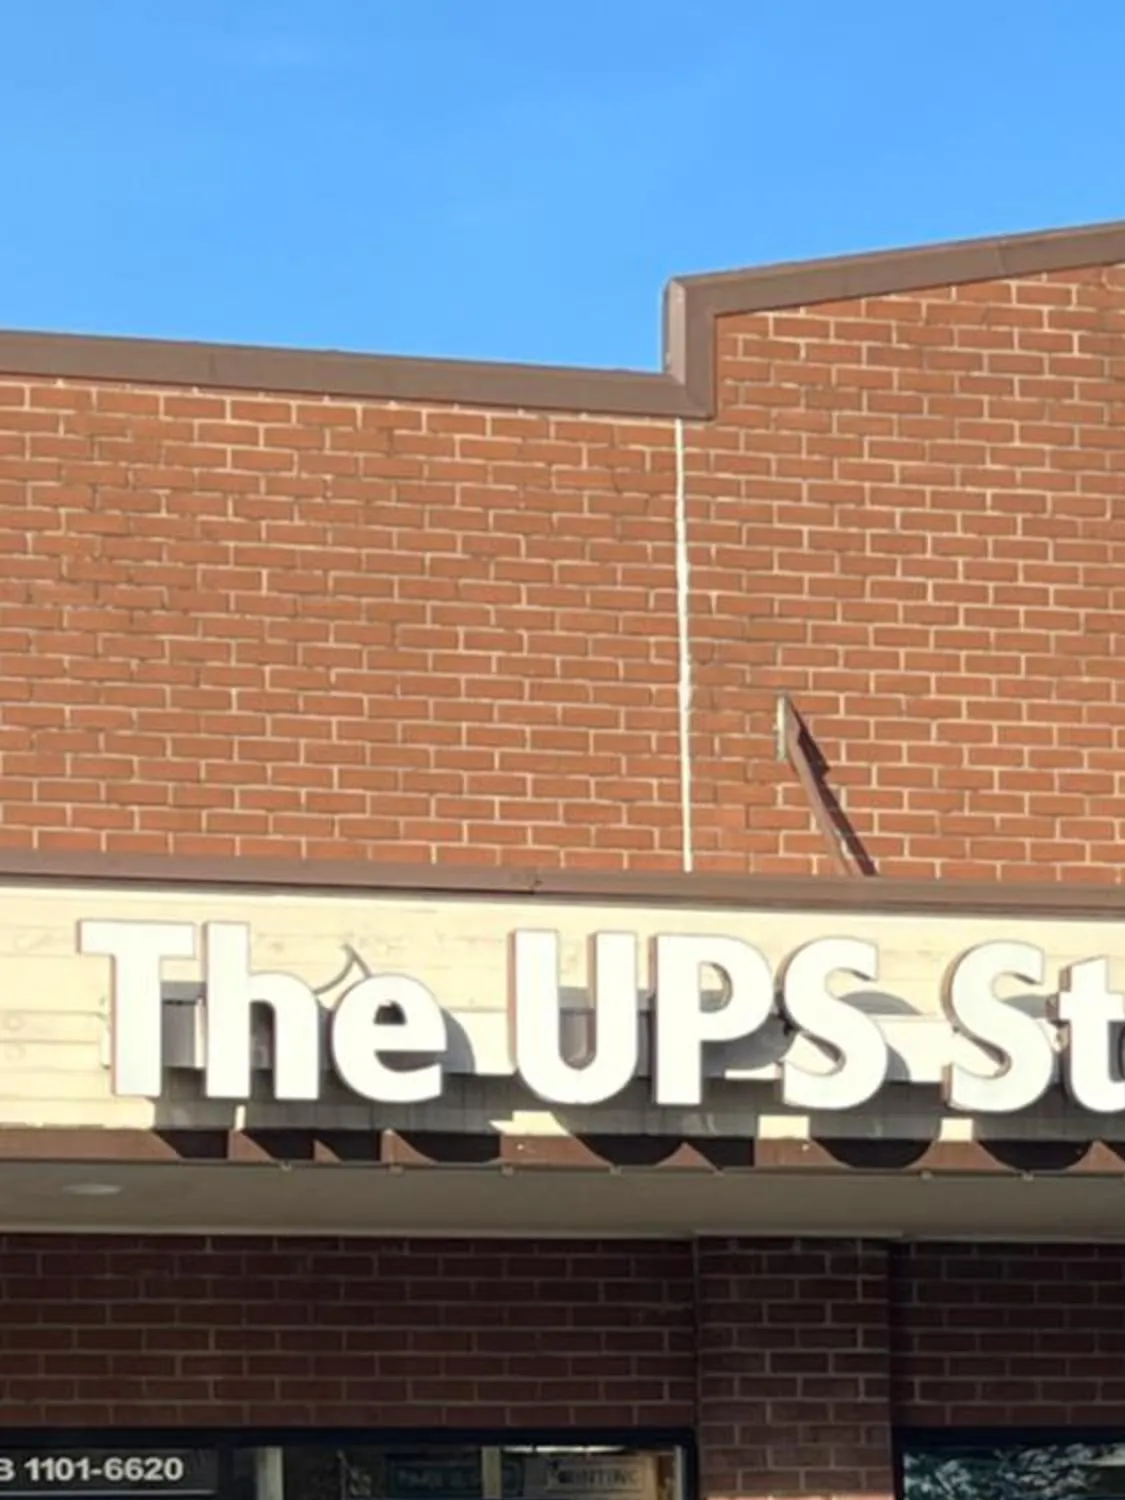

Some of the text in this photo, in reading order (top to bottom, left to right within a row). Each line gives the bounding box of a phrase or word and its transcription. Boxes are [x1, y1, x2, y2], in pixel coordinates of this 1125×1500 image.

[77, 919, 448, 1104] The
[508, 929, 889, 1111] UPS
[24, 1457, 184, 1481] 1101-6620
